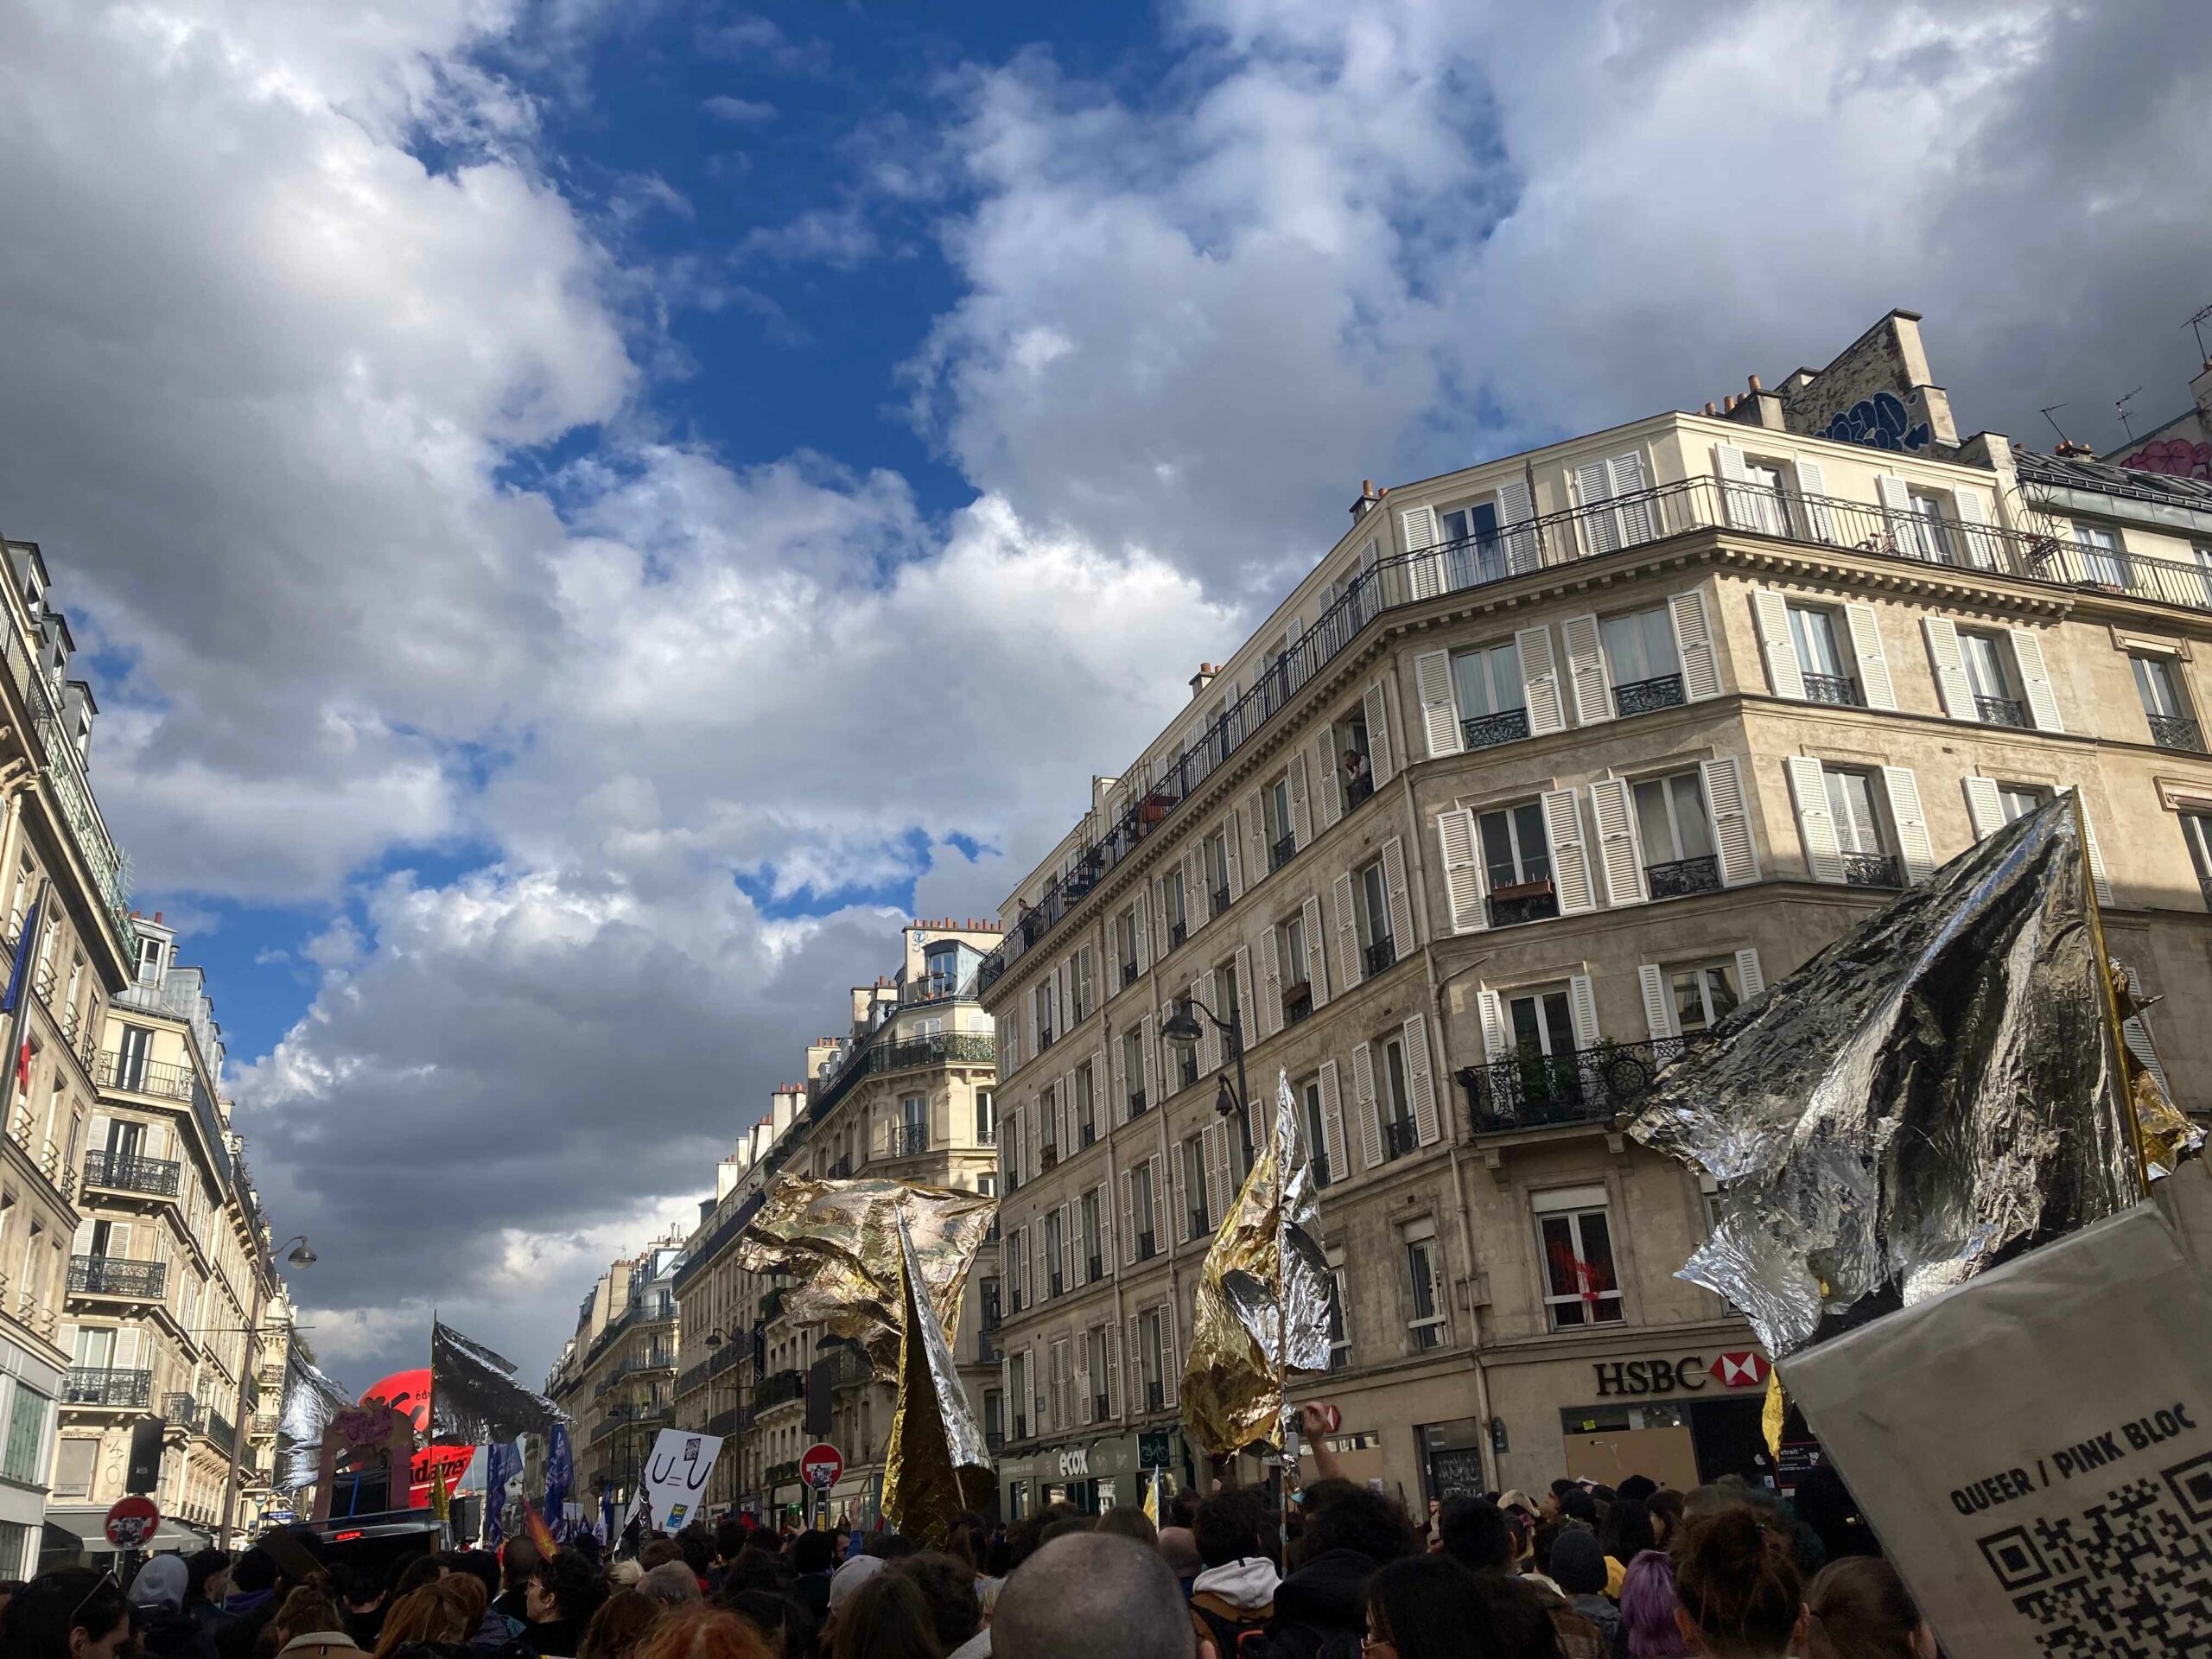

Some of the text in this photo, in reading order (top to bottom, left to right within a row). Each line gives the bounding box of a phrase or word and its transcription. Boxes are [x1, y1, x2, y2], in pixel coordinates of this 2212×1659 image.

[1592, 1356, 1707, 1396] HSBC
[1059, 1448, 1089, 1477] ecox
[1950, 1402, 2197, 1516] QUEER / PINK BLOC
